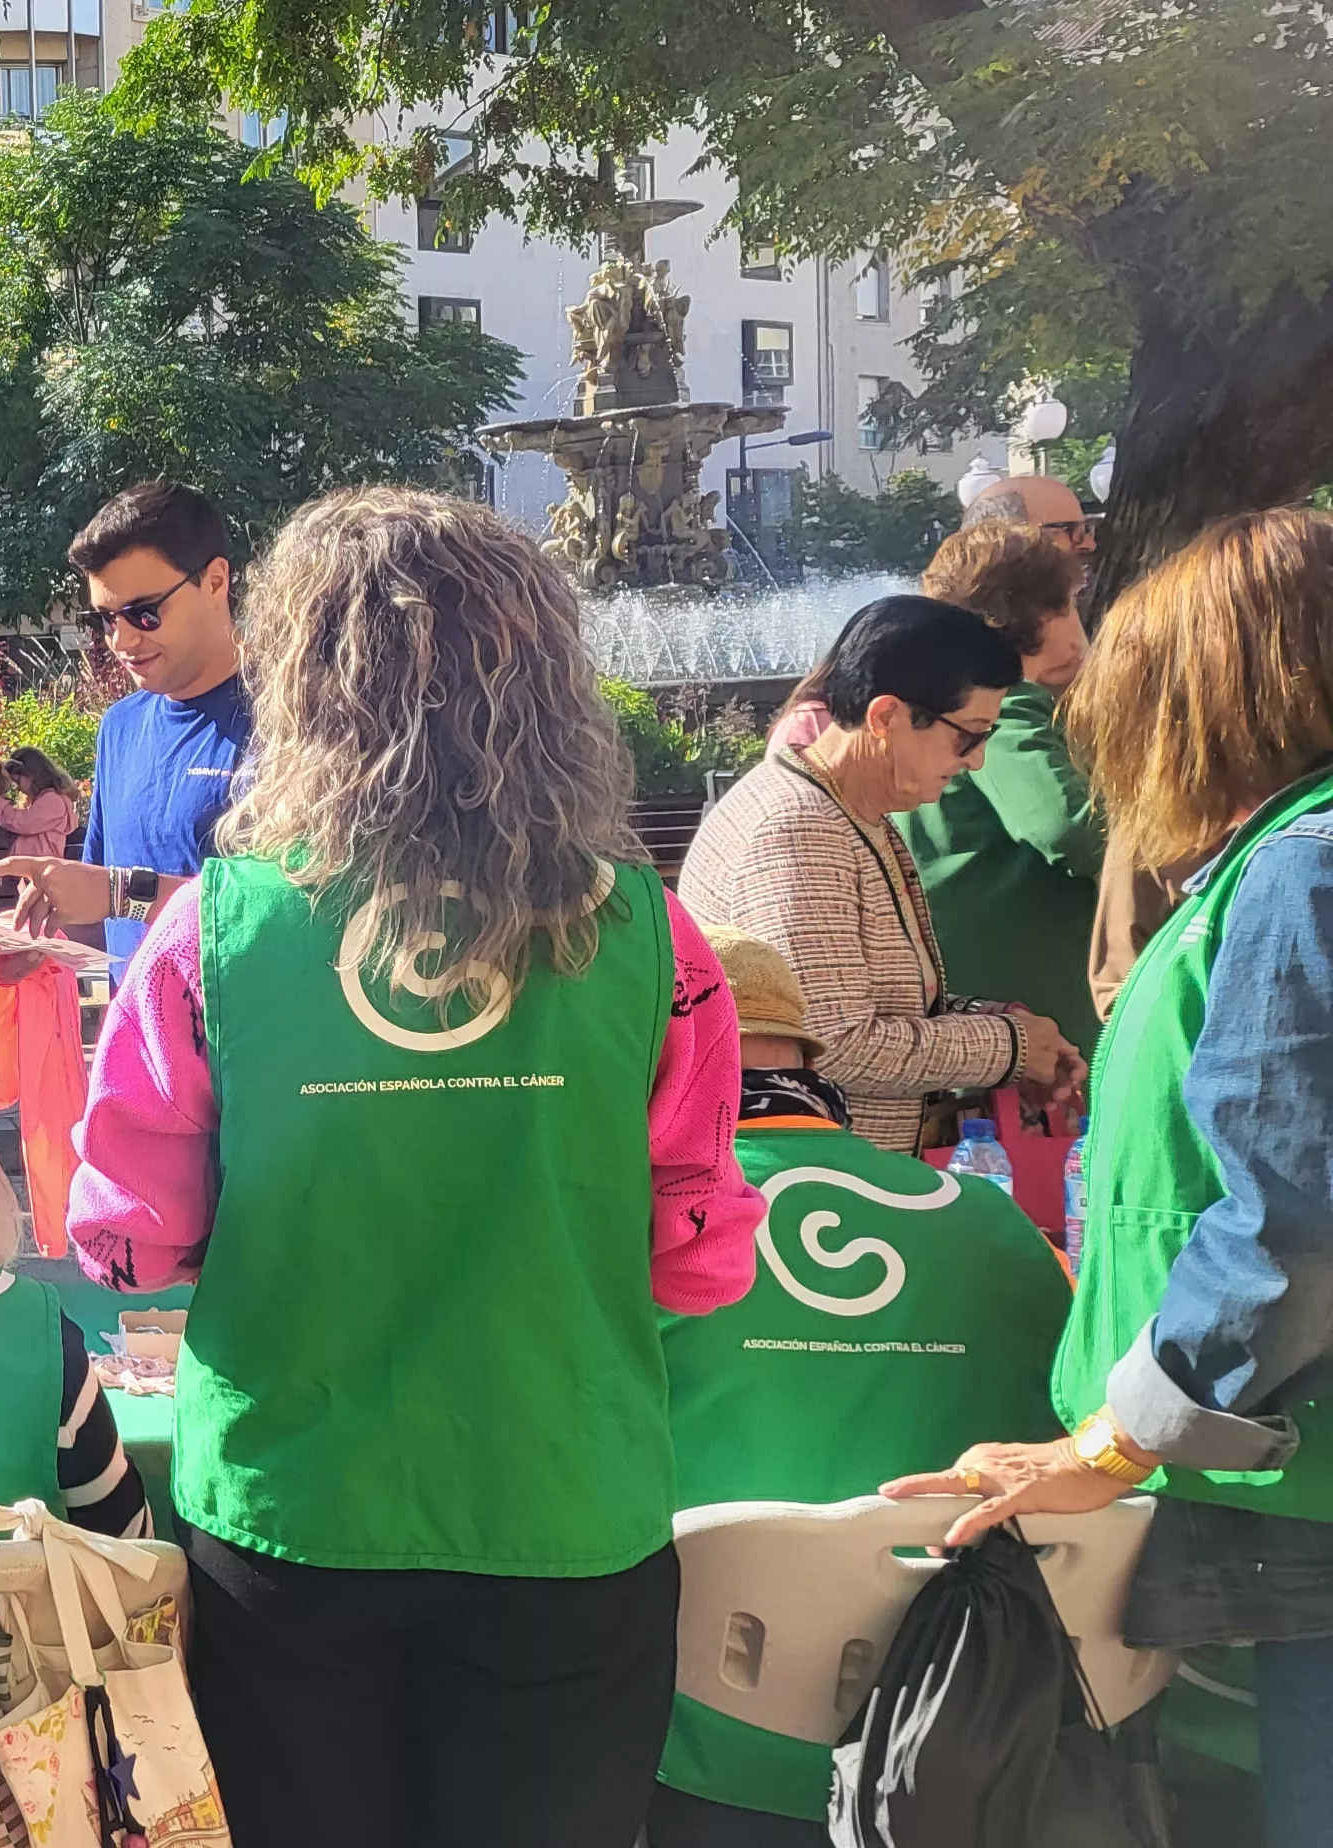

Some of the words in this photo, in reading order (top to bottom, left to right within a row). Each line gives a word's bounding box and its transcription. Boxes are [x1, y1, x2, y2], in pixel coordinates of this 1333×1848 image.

[300, 1079, 377, 1095] ASOCIACIÓN
[379, 1077, 445, 1092] ESPAÑOLA
[447, 1077, 501, 1089] CONTRA
[503, 1077, 519, 1087] EL
[520, 1073, 565, 1087] CÁNCER
[743, 1339, 808, 1351] ASOCIACIÓN
[864, 1342, 911, 1353] CONTRA
[911, 1343, 925, 1353] EL
